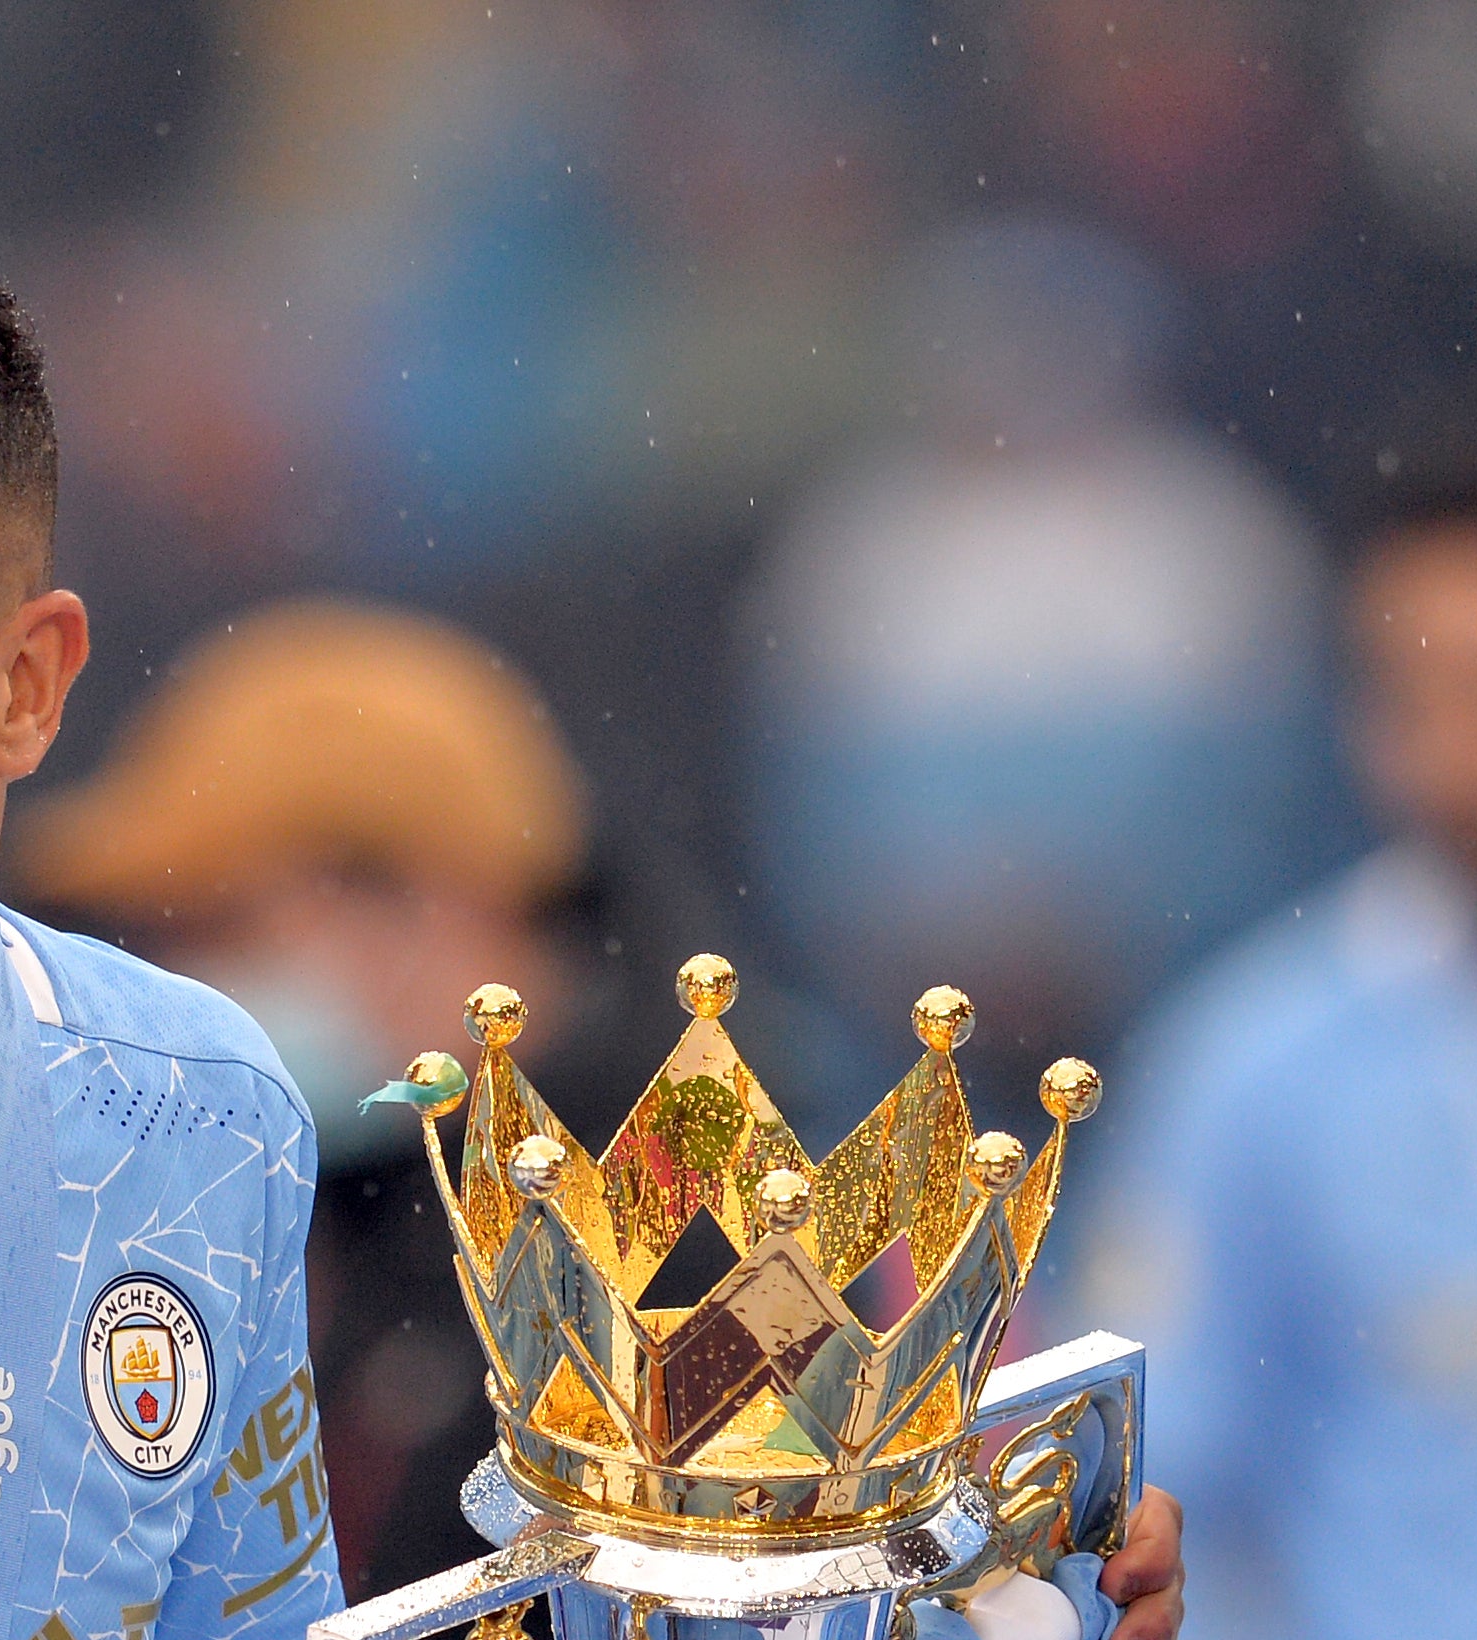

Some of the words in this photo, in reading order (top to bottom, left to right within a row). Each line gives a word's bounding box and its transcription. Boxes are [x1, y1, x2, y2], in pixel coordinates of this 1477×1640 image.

[91, 1289, 195, 1353] MANCHESTER
[188, 1369, 202, 1380] 94
[134, 1445, 174, 1464] CITY
